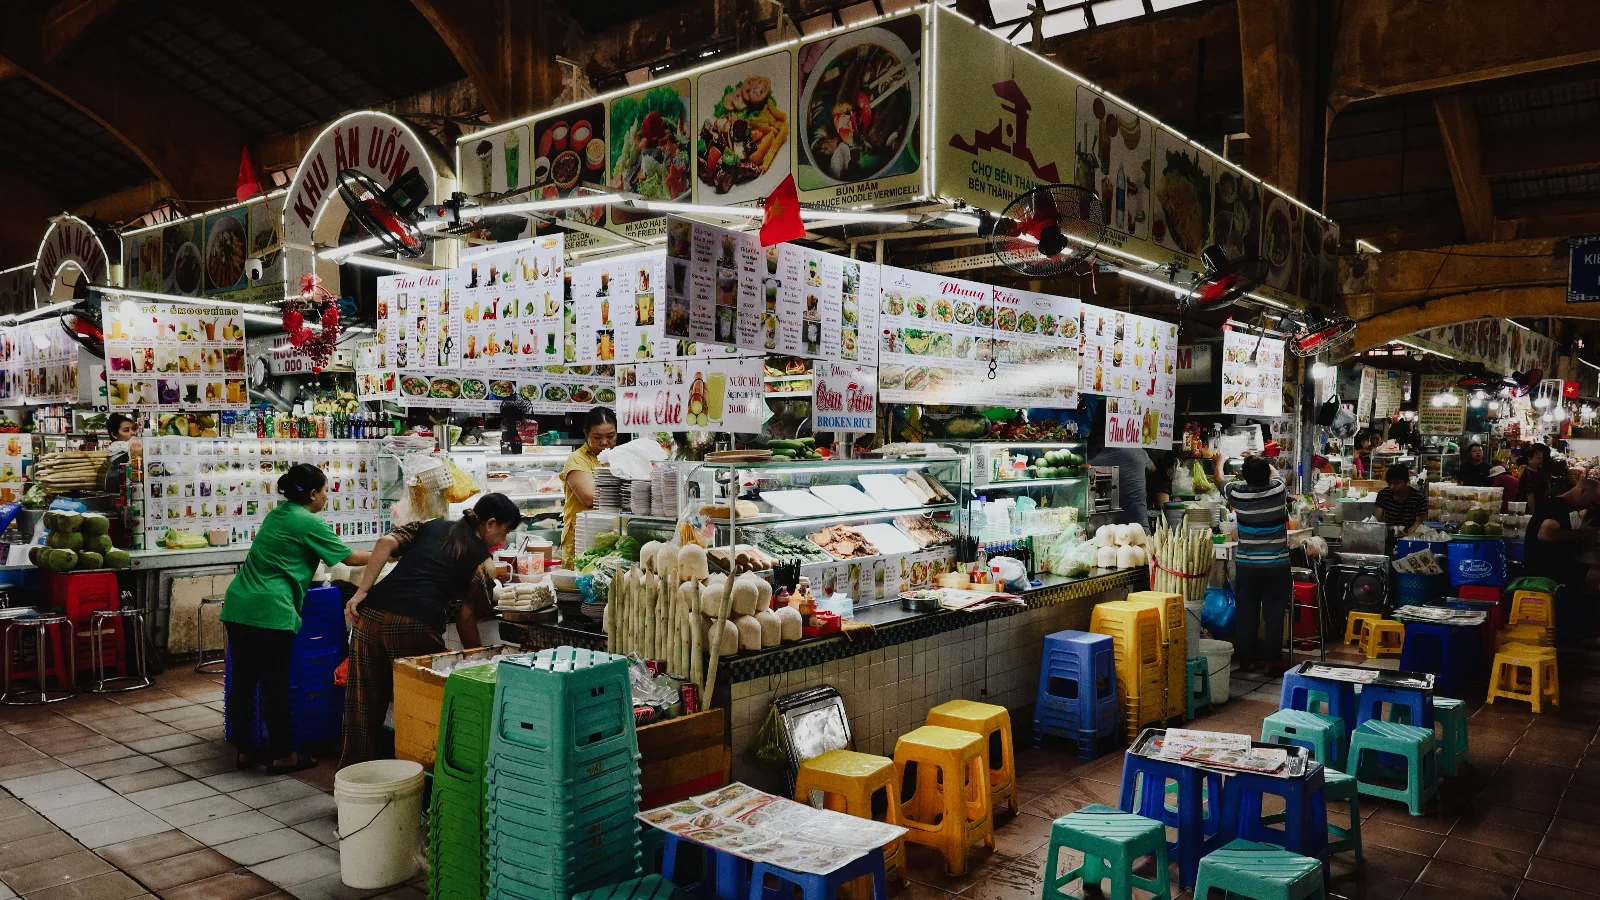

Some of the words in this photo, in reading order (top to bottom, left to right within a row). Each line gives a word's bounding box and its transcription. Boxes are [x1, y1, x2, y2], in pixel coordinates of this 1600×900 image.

[293, 152, 329, 229] KHU
[334, 126, 360, 172] ĂN
[367, 126, 420, 184] UỐN
[971, 160, 993, 181] CHỢ
[994, 167, 1013, 186] BẾN
[817, 197, 841, 207] SAUCE
[841, 191, 873, 205] NOODLE
[874, 184, 921, 200] VERMICELLI
[836, 183, 855, 197] BÚN
[637, 229, 657, 237] FRIED
[41, 242, 58, 292] KHU
[394, 278, 415, 289] Thu
[277, 358, 302, 372] 1.000
[622, 390, 651, 427] Thu
[817, 415, 852, 428] BROKEN
[853, 417, 873, 429] RICE
[1108, 416, 1125, 443] Thu
